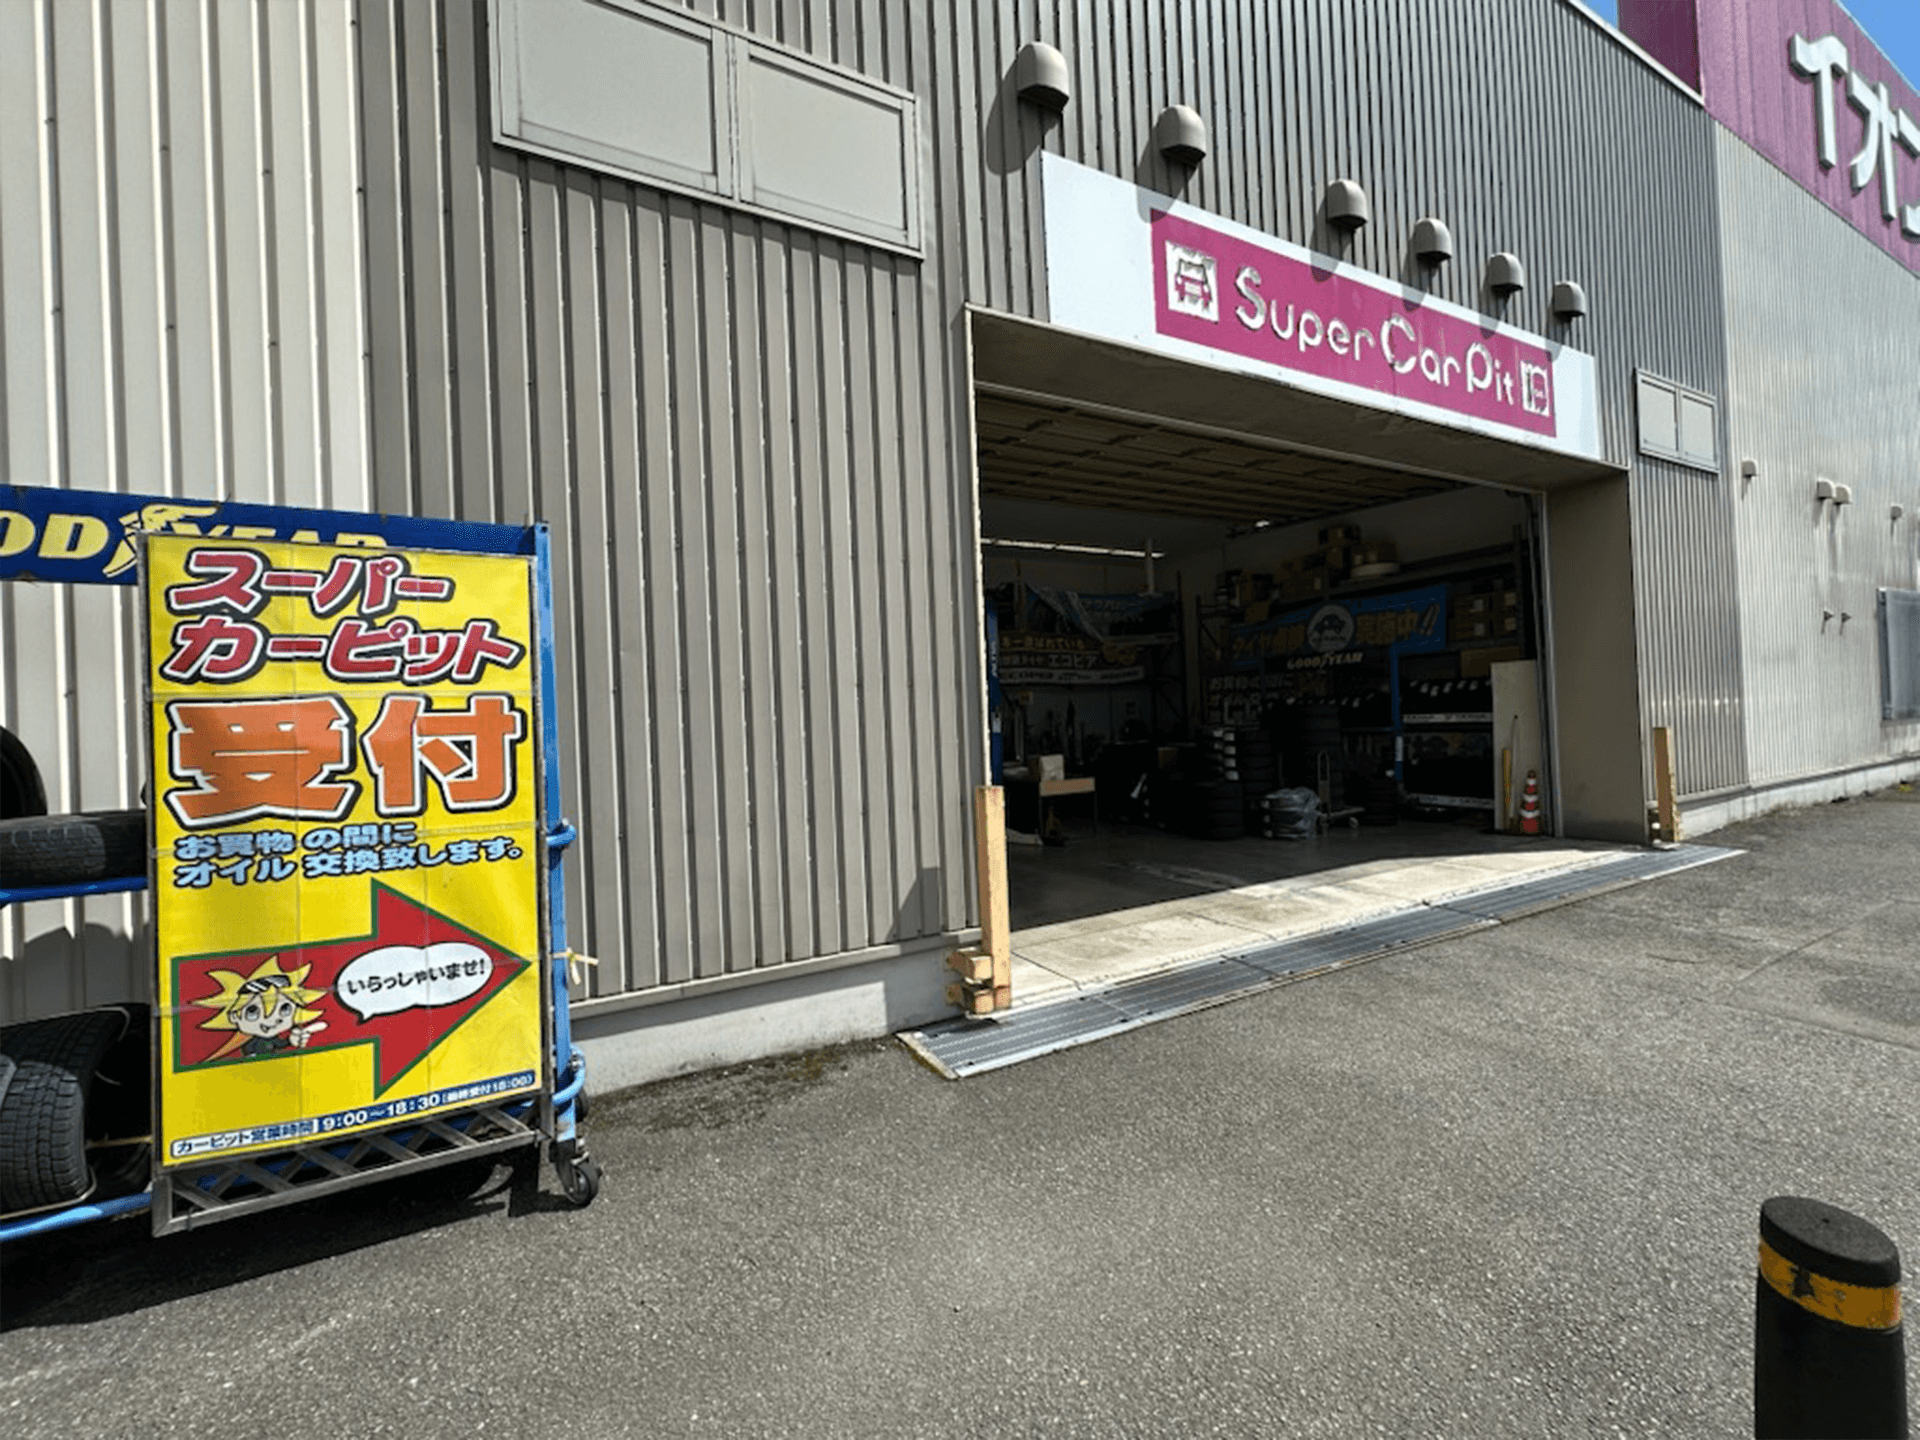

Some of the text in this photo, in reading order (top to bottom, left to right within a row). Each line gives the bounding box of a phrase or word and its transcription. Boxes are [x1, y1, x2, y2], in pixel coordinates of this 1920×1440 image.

[1235, 265, 1515, 406] Super Car Pit
[165, 547, 454, 615] スーパー
[162, 616, 526, 683] カーピット
[165, 693, 526, 829] 受付
[346, 957, 486, 995] いらっしゃいませ!
